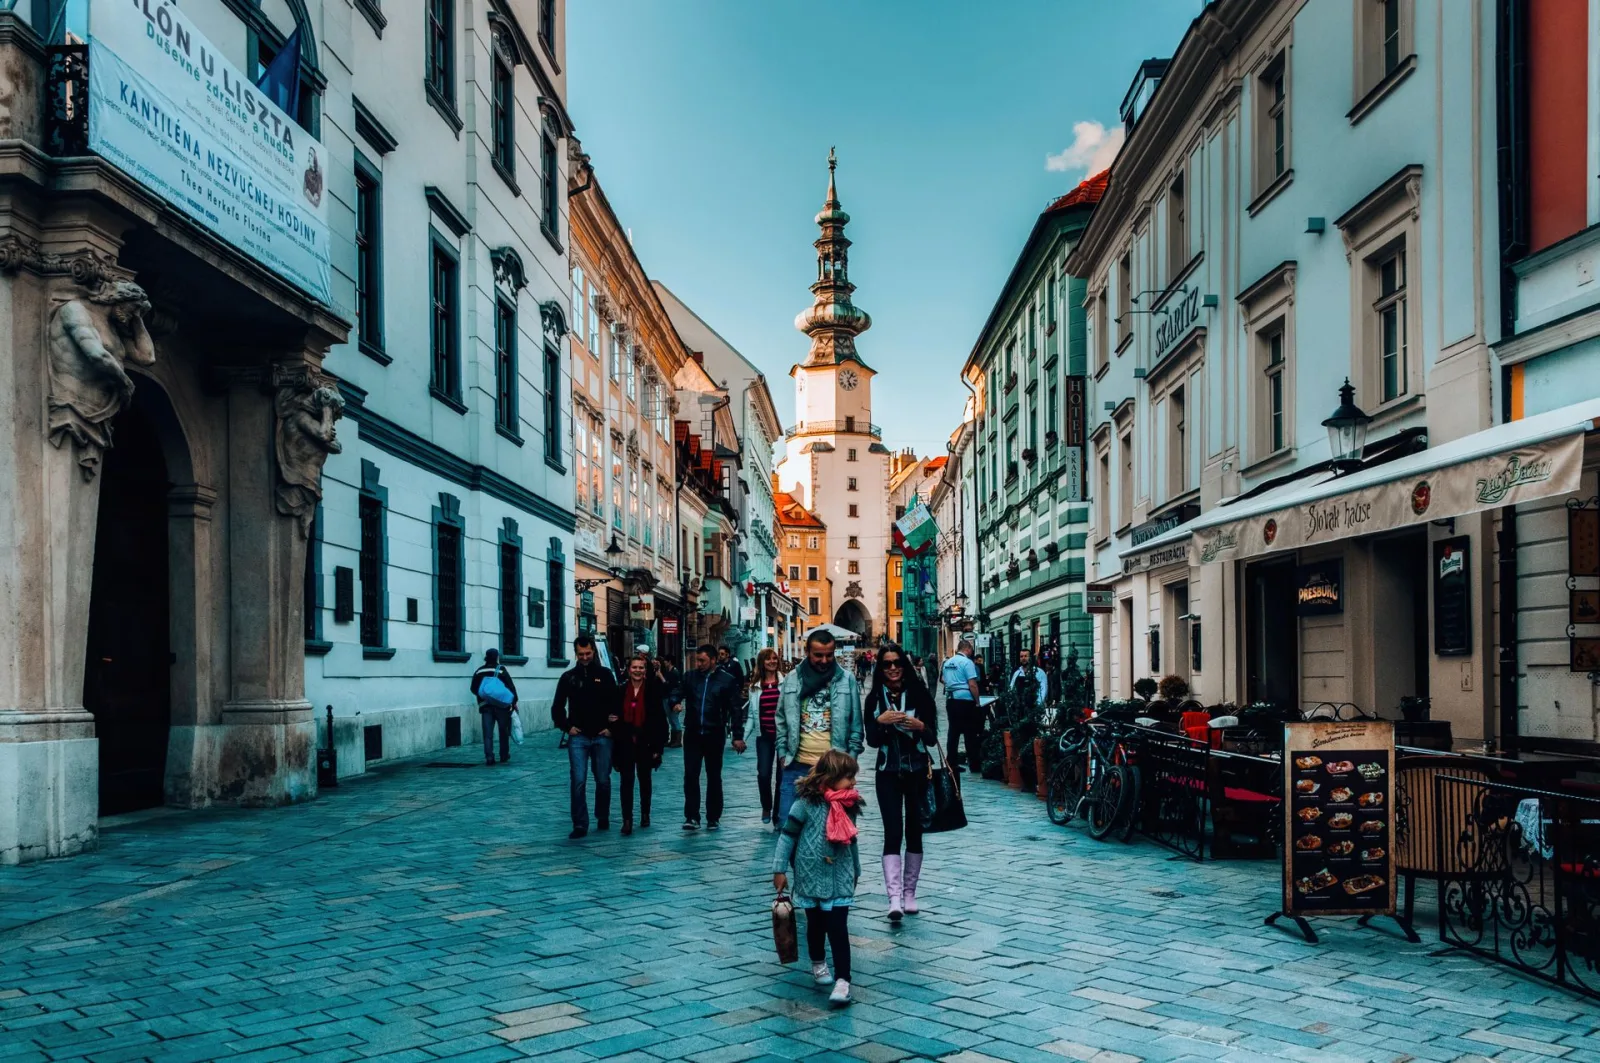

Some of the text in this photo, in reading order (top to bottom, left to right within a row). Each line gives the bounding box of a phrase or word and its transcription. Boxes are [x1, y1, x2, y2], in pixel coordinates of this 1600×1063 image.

[133, 0, 294, 151] LÓN U LISZTA
[147, 21, 200, 81] Duševné
[206, 80, 248, 123] zdravie
[253, 122, 258, 133] a
[264, 127, 294, 163] hudba
[121, 80, 200, 160] KANTILÉNA
[208, 149, 274, 214] NEZVUČNEJ
[278, 204, 316, 246] HODINY
[1155, 286, 1199, 358] SKARITZ
[1071, 380, 1081, 444] HOTEL
[1306, 502, 1371, 541] Slovak hause
[1298, 583, 1338, 604] PRESBURG
